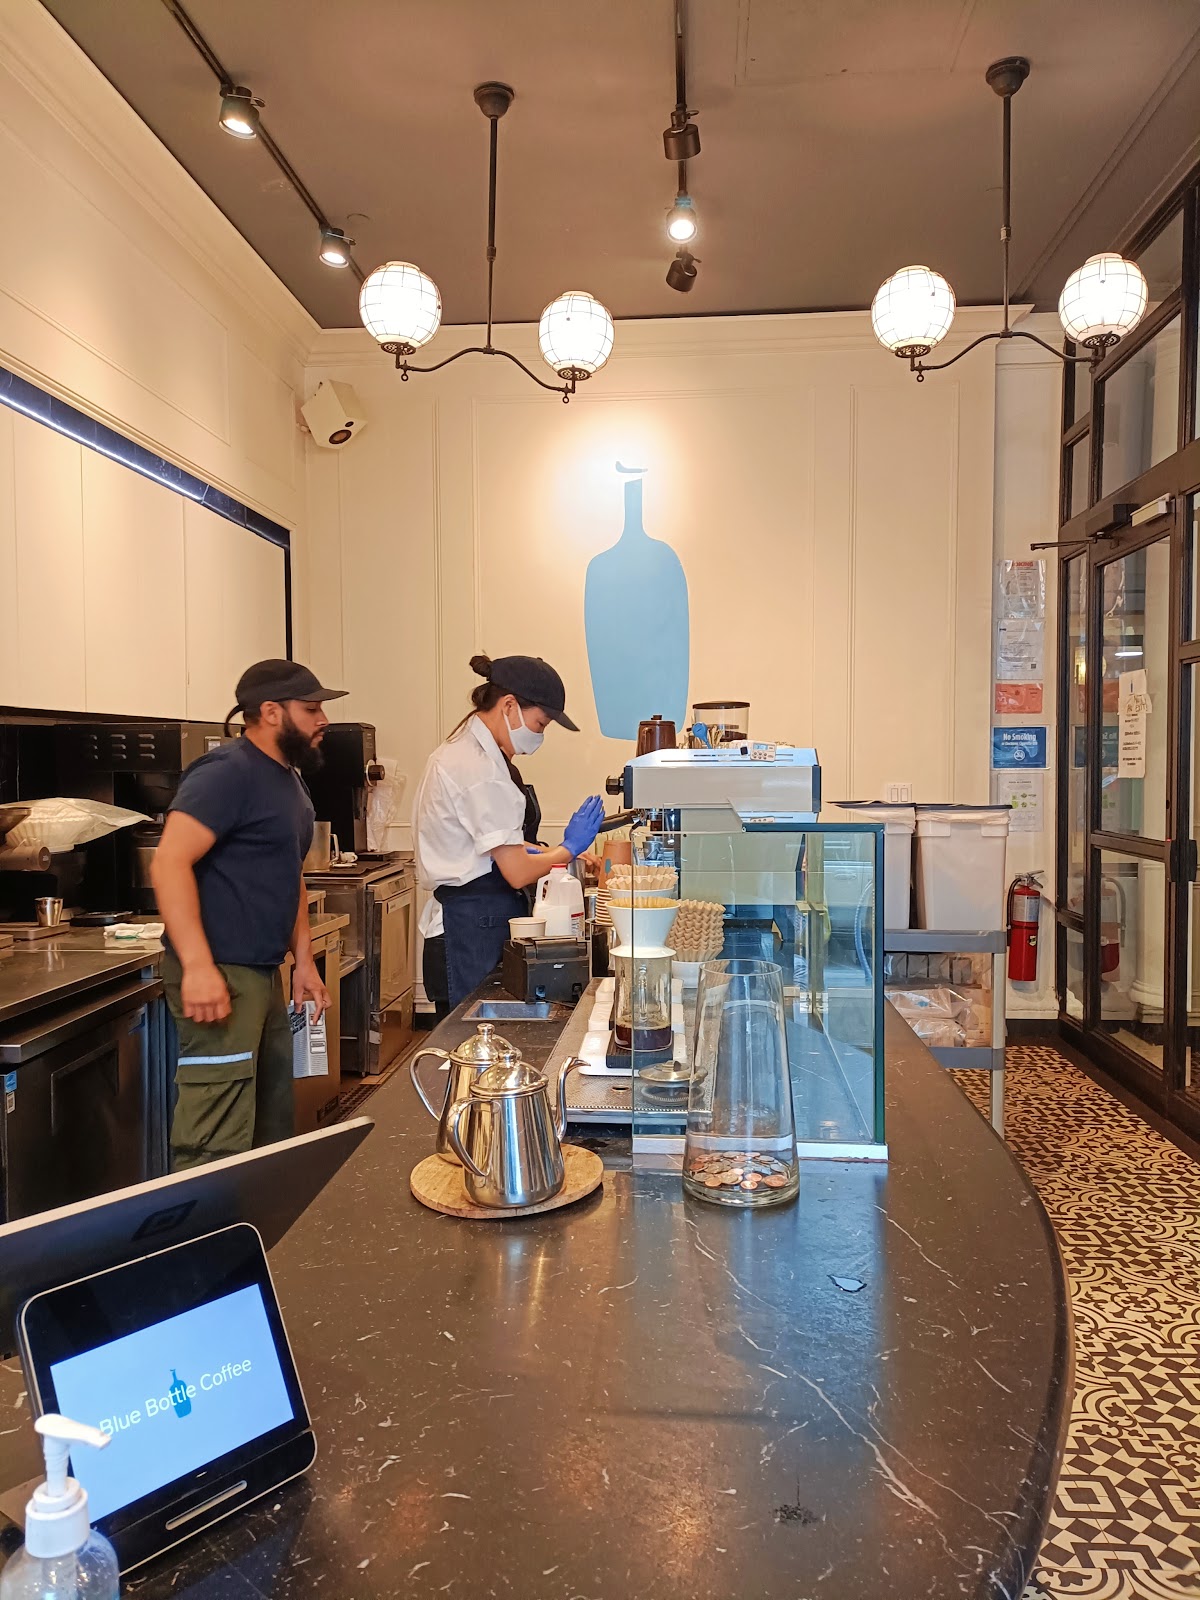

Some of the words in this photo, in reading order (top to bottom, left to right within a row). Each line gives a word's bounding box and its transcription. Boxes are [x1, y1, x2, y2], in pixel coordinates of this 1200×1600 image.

[1003, 733, 1011, 741] No
[1011, 733, 1037, 742] Smoking
[99, 1410, 142, 1437] Blue
[144, 1384, 197, 1418] Bottle
[199, 1359, 252, 1391] Coffee
